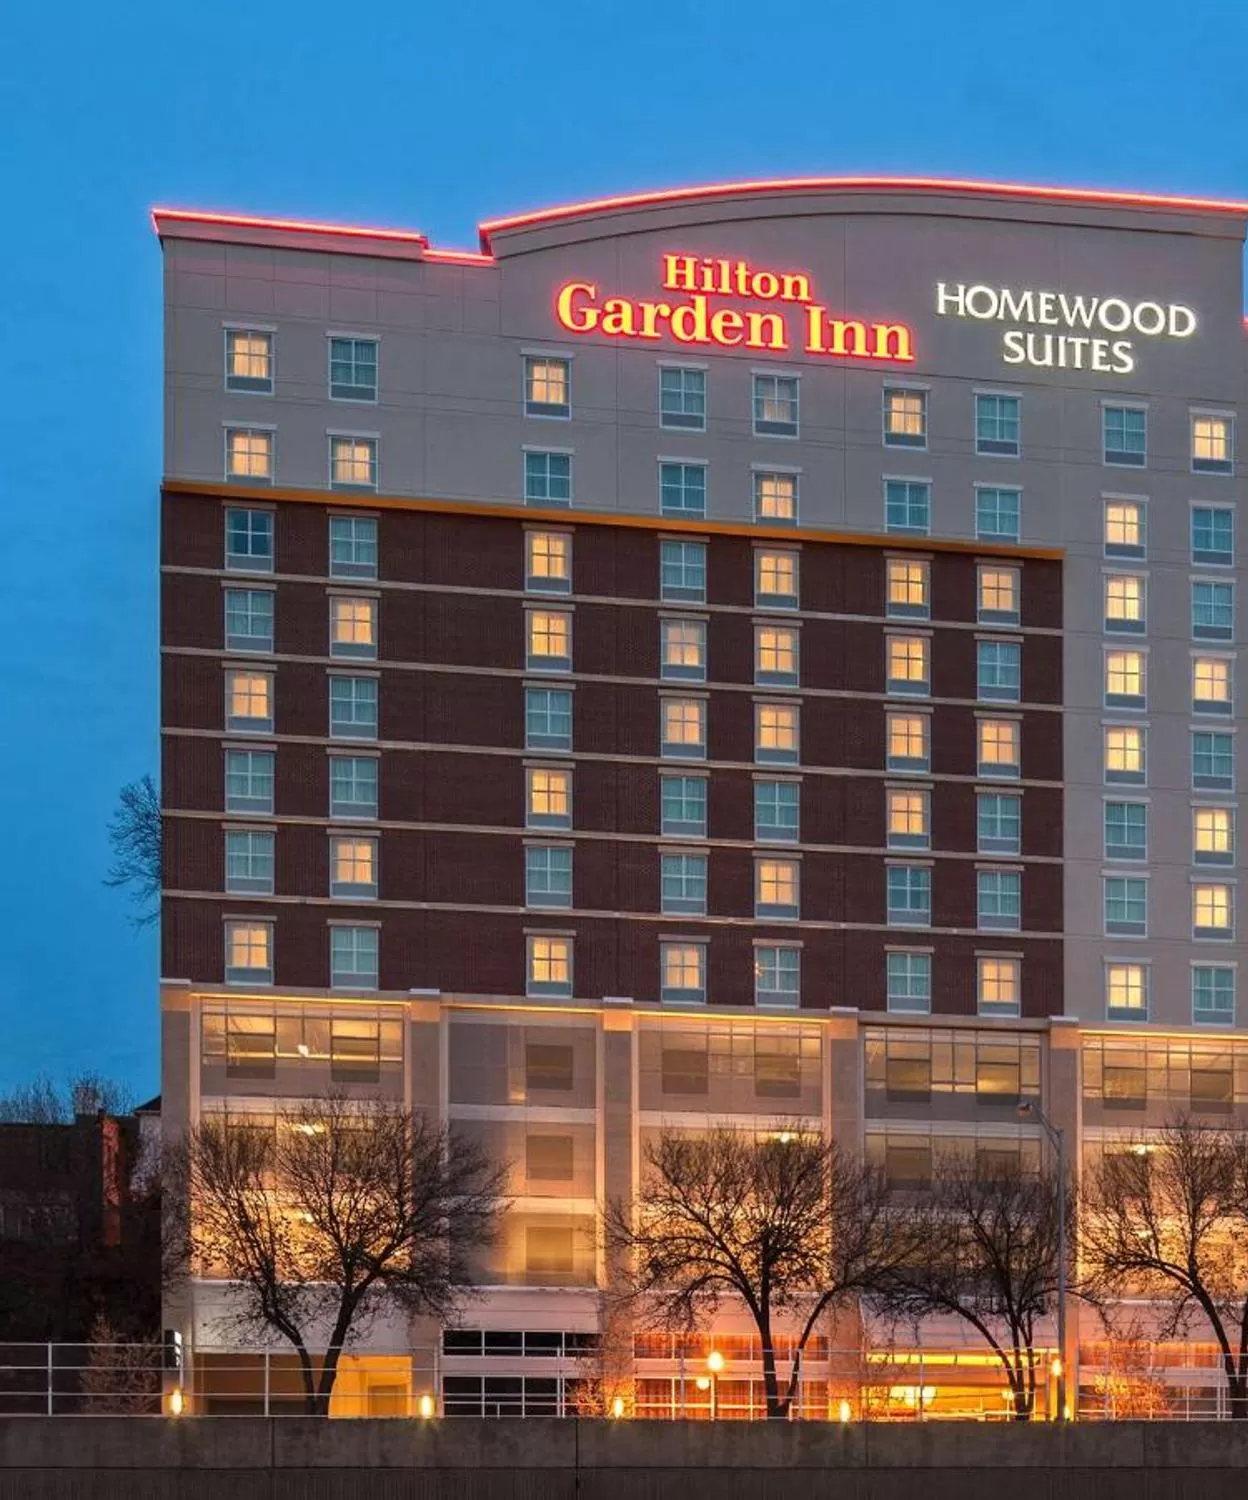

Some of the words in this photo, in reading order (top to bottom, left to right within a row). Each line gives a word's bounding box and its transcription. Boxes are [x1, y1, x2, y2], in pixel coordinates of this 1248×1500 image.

[663, 254, 812, 301] Hilton
[557, 283, 788, 349] Garden
[804, 305, 914, 360] Inn
[936, 282, 1197, 337] HOMEWOOD
[1003, 331, 1134, 374] SUITES
